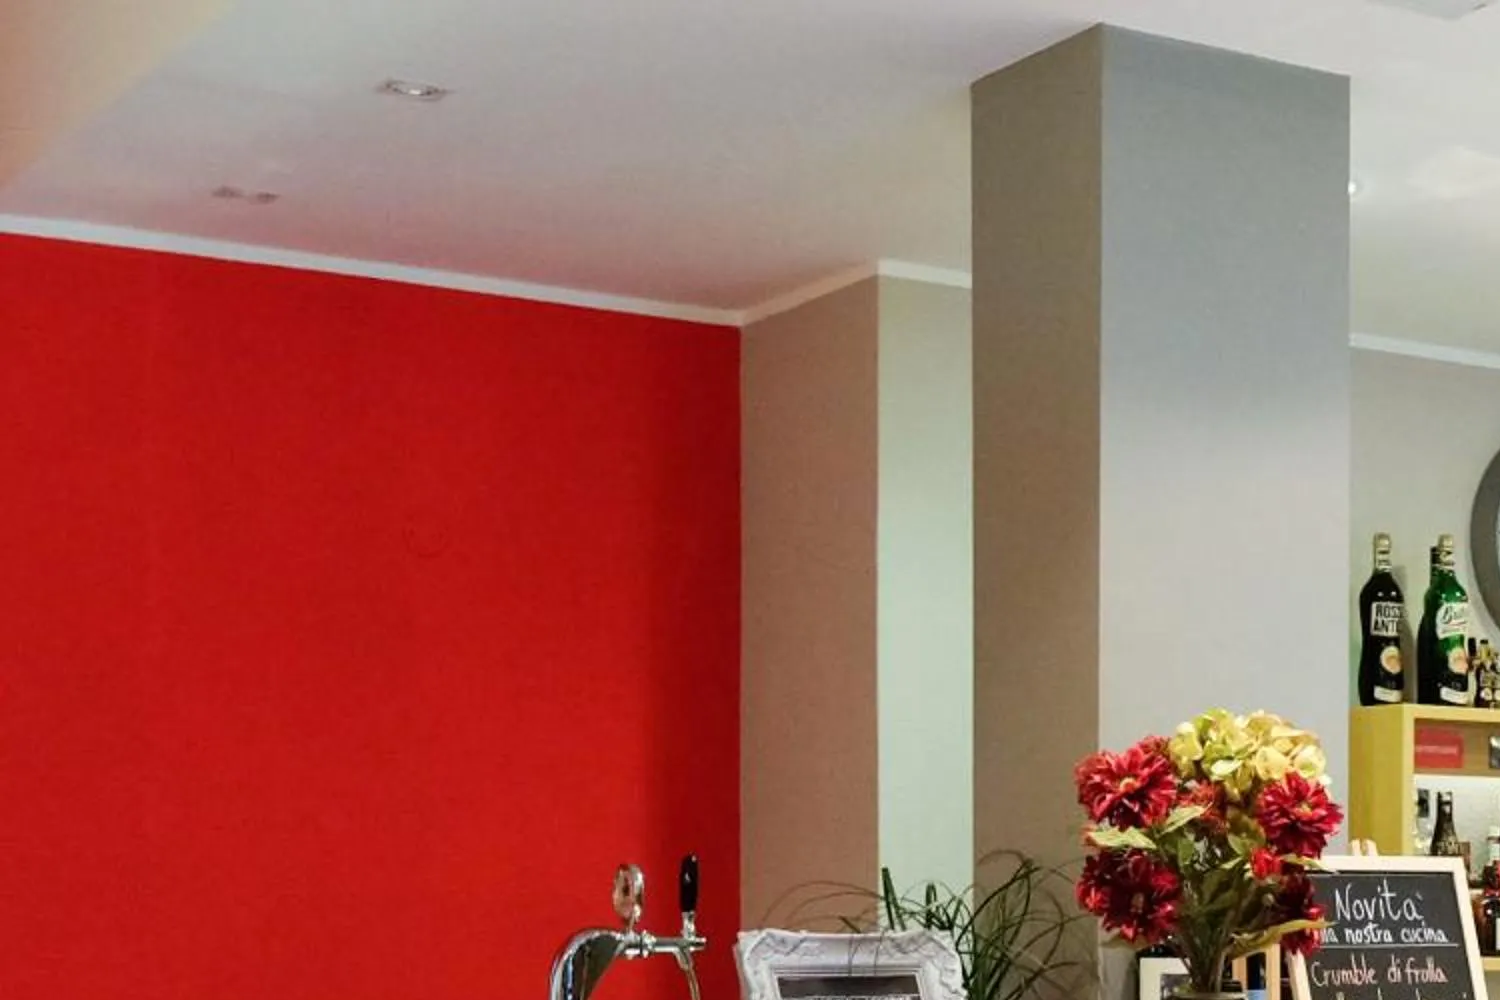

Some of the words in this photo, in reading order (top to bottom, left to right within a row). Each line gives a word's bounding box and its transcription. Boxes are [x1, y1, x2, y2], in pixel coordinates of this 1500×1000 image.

[1345, 921, 1393, 944] nostra
[1400, 921, 1449, 943] cucina
[1310, 953, 1378, 987] Crumble
[1387, 953, 1401, 984] di
[1405, 955, 1449, 984] frolla
